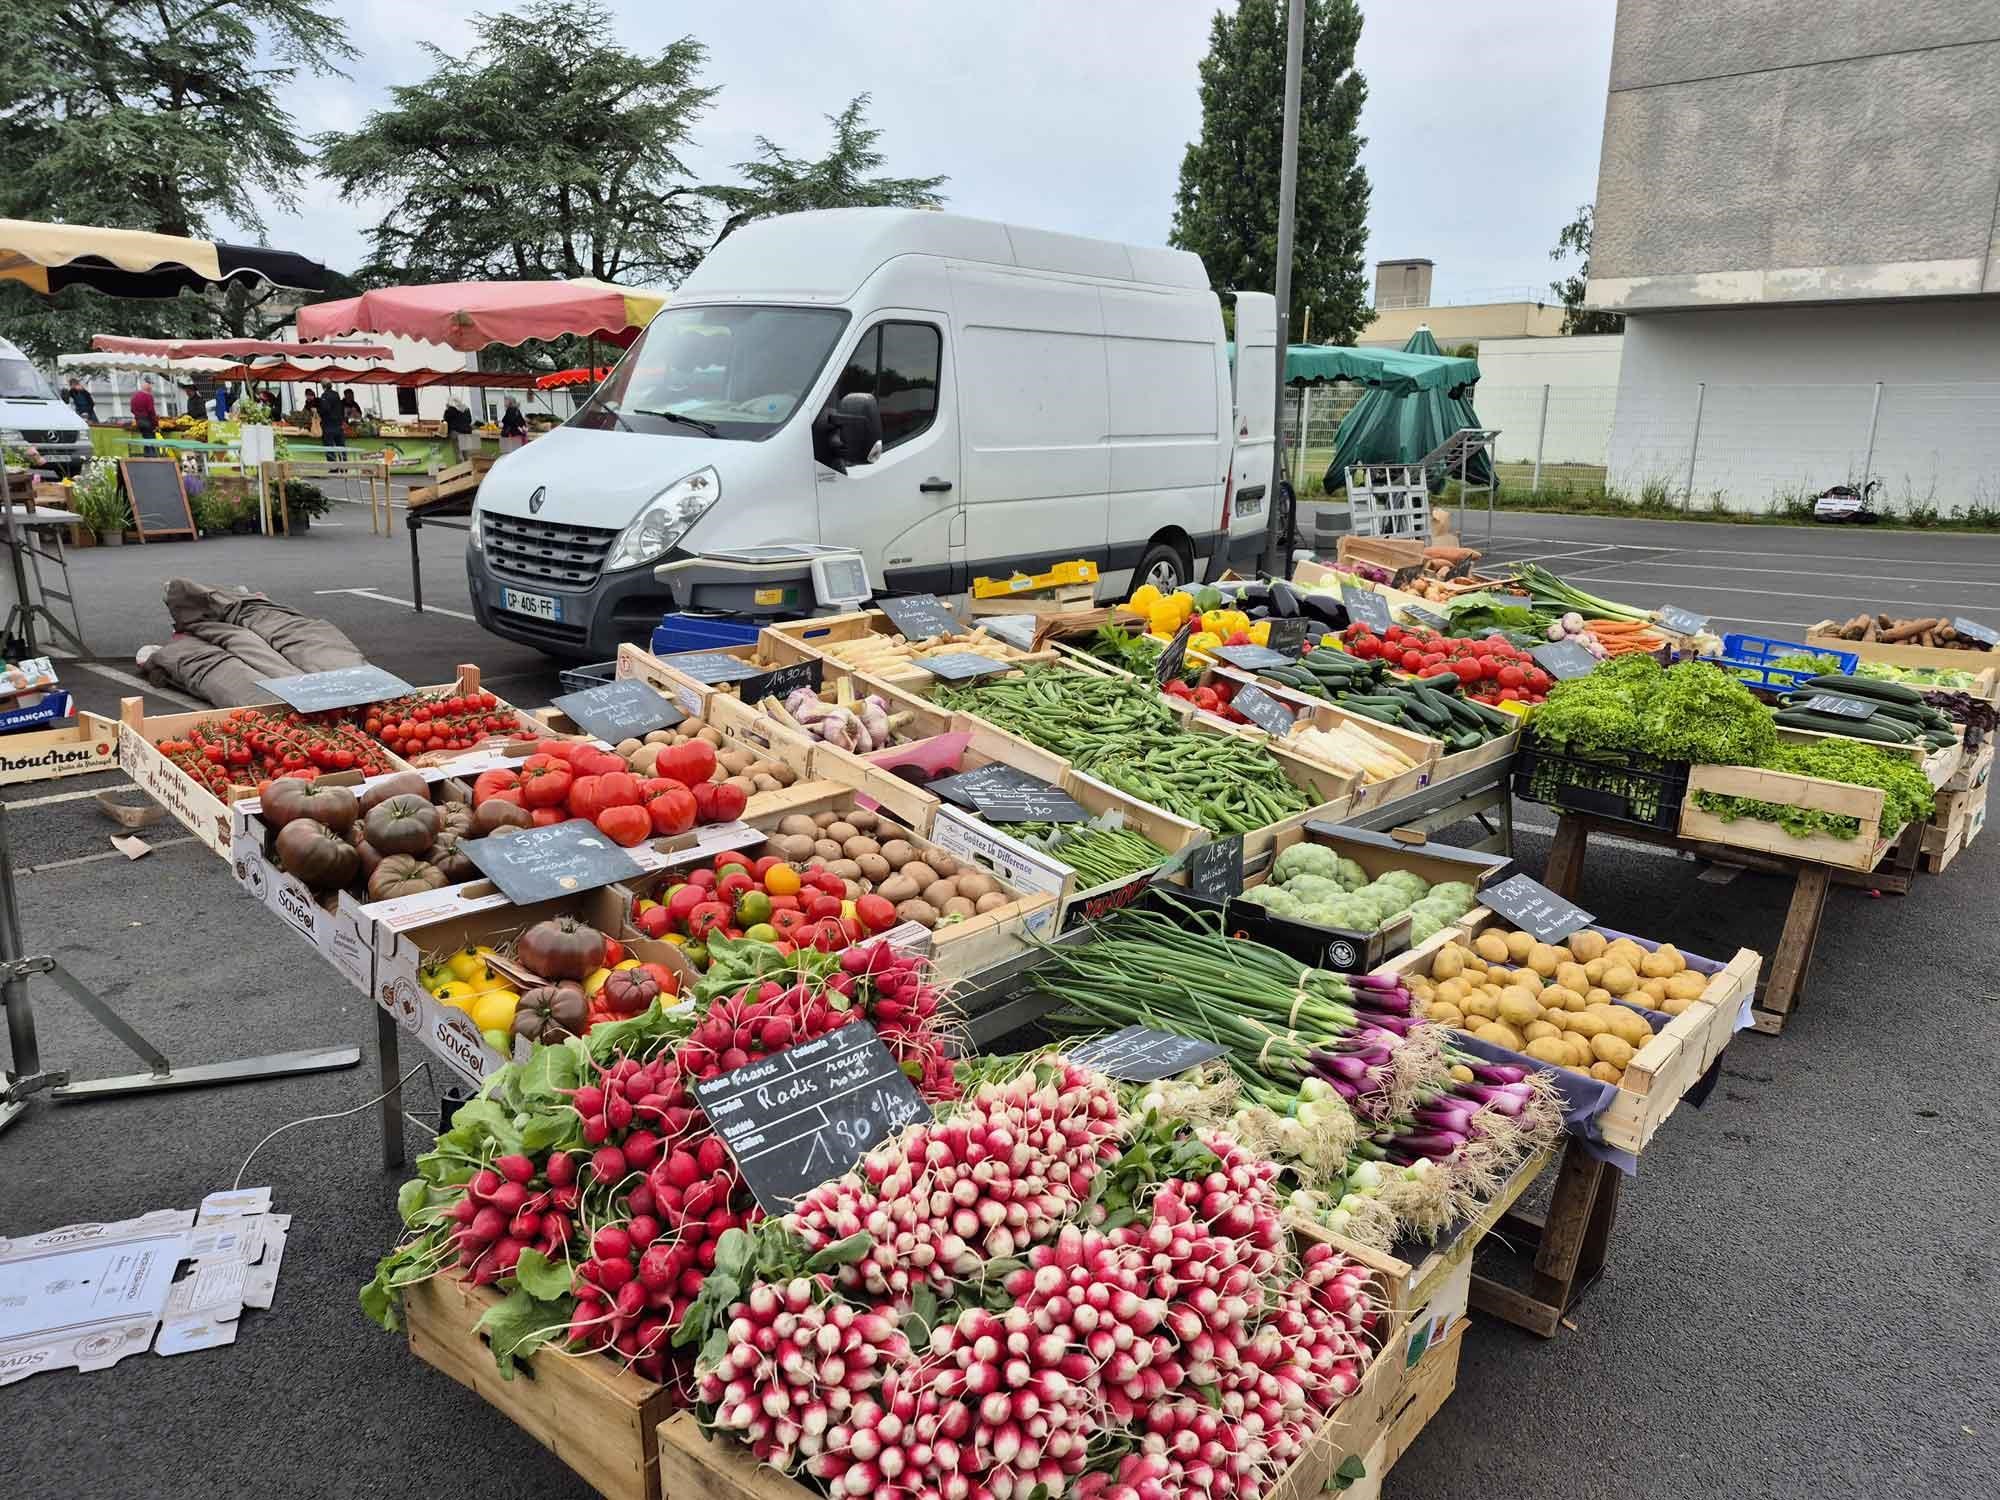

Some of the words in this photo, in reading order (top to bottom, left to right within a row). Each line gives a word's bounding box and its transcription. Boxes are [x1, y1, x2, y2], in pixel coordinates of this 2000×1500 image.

[7, 709, 54, 725] FRANÇAIS
[160, 760, 187, 796] Jardin
[278, 889, 316, 934] Savéol
[437, 1023, 484, 1077] Savéol
[731, 1064, 778, 1086] France
[829, 1066, 870, 1089] roses
[711, 1098, 744, 1117] Produit
[756, 1079, 818, 1110] Radis
